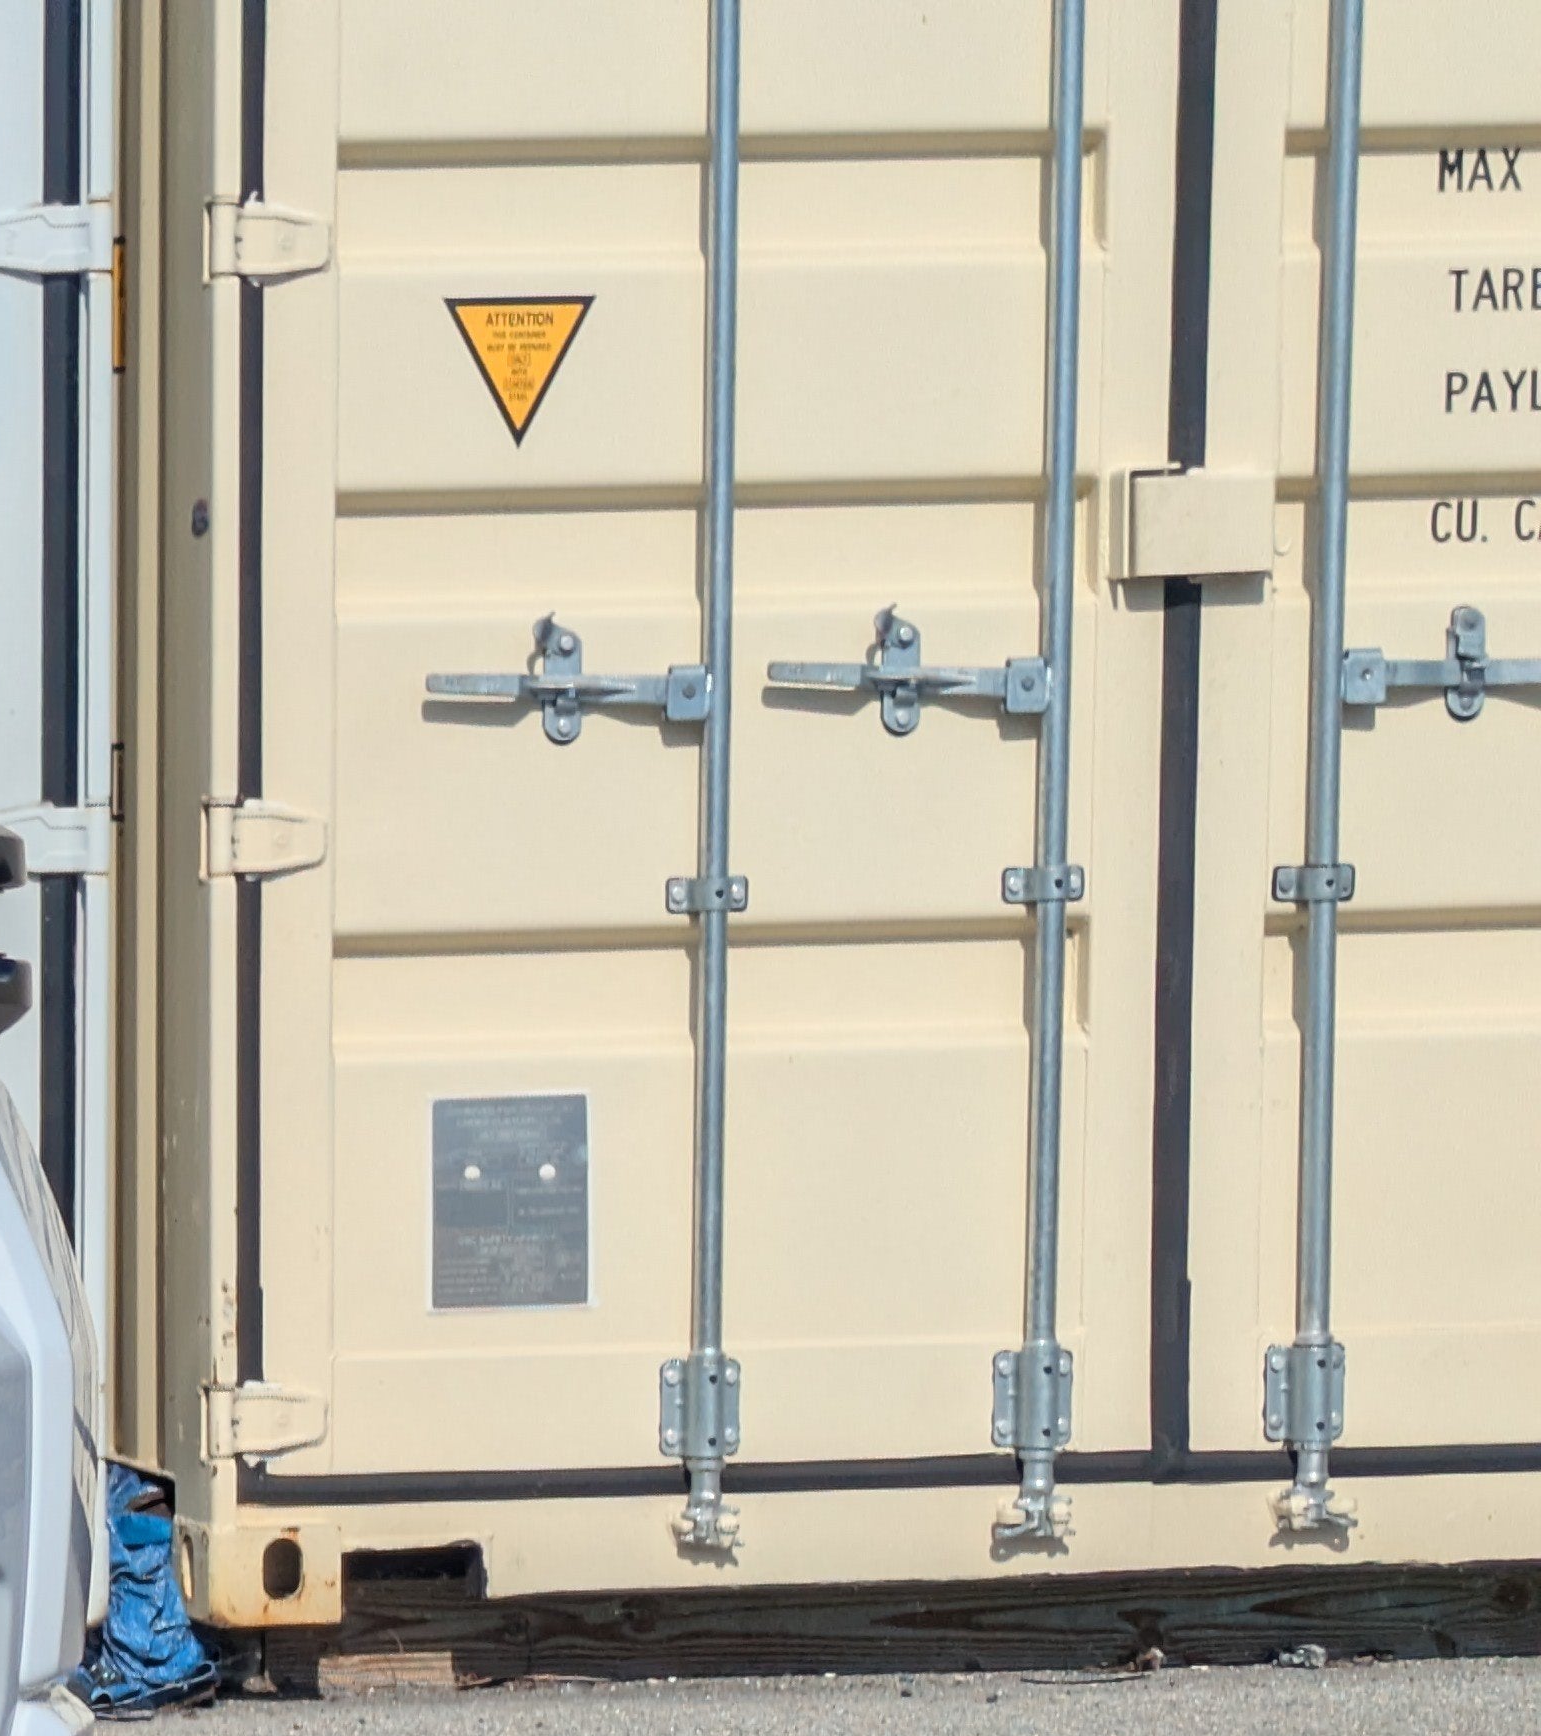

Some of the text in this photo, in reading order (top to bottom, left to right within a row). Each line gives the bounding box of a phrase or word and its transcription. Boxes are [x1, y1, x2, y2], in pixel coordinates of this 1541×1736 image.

[1438, 147, 1522, 192] MAX
[485, 312, 554, 328] ATTENTION
[1431, 500, 1488, 543] CU.
